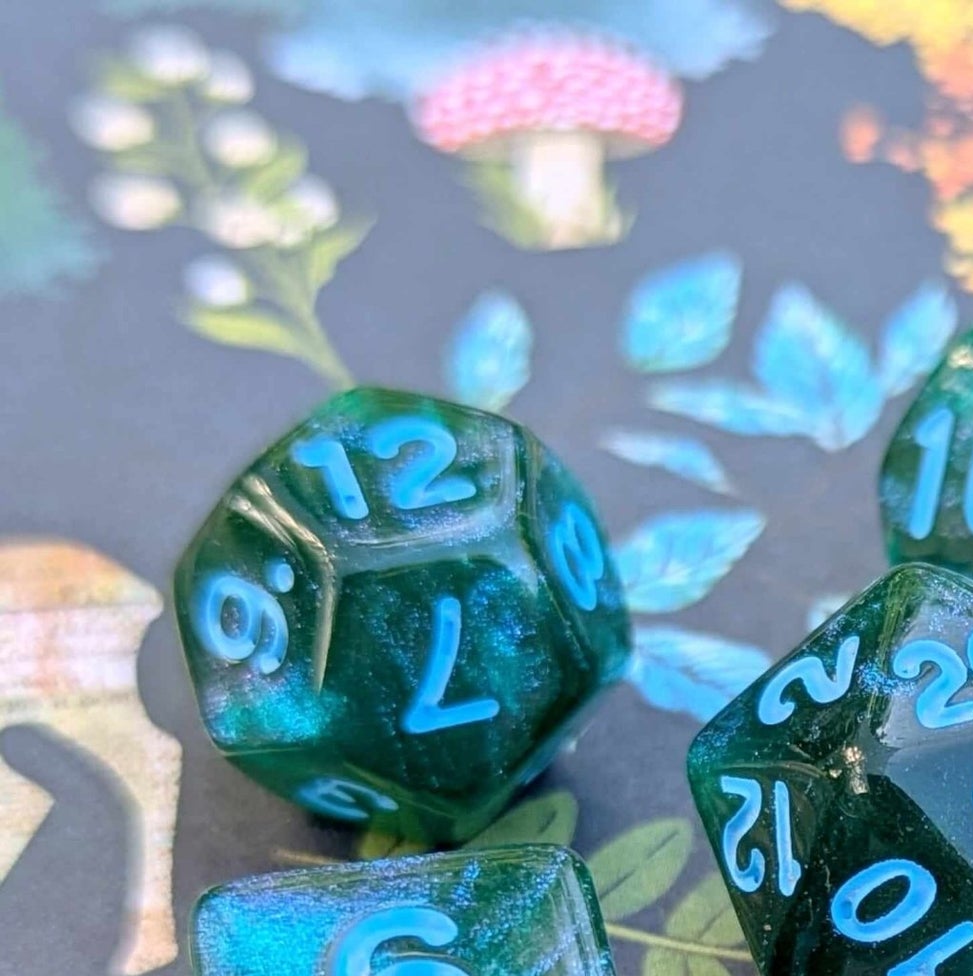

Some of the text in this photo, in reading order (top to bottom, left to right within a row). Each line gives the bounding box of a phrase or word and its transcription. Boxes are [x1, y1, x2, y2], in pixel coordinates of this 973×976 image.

[290, 416, 477, 519] 12
[402, 597, 500, 734] 7
[759, 635, 860, 725] 2
[720, 774, 802, 896] 12
